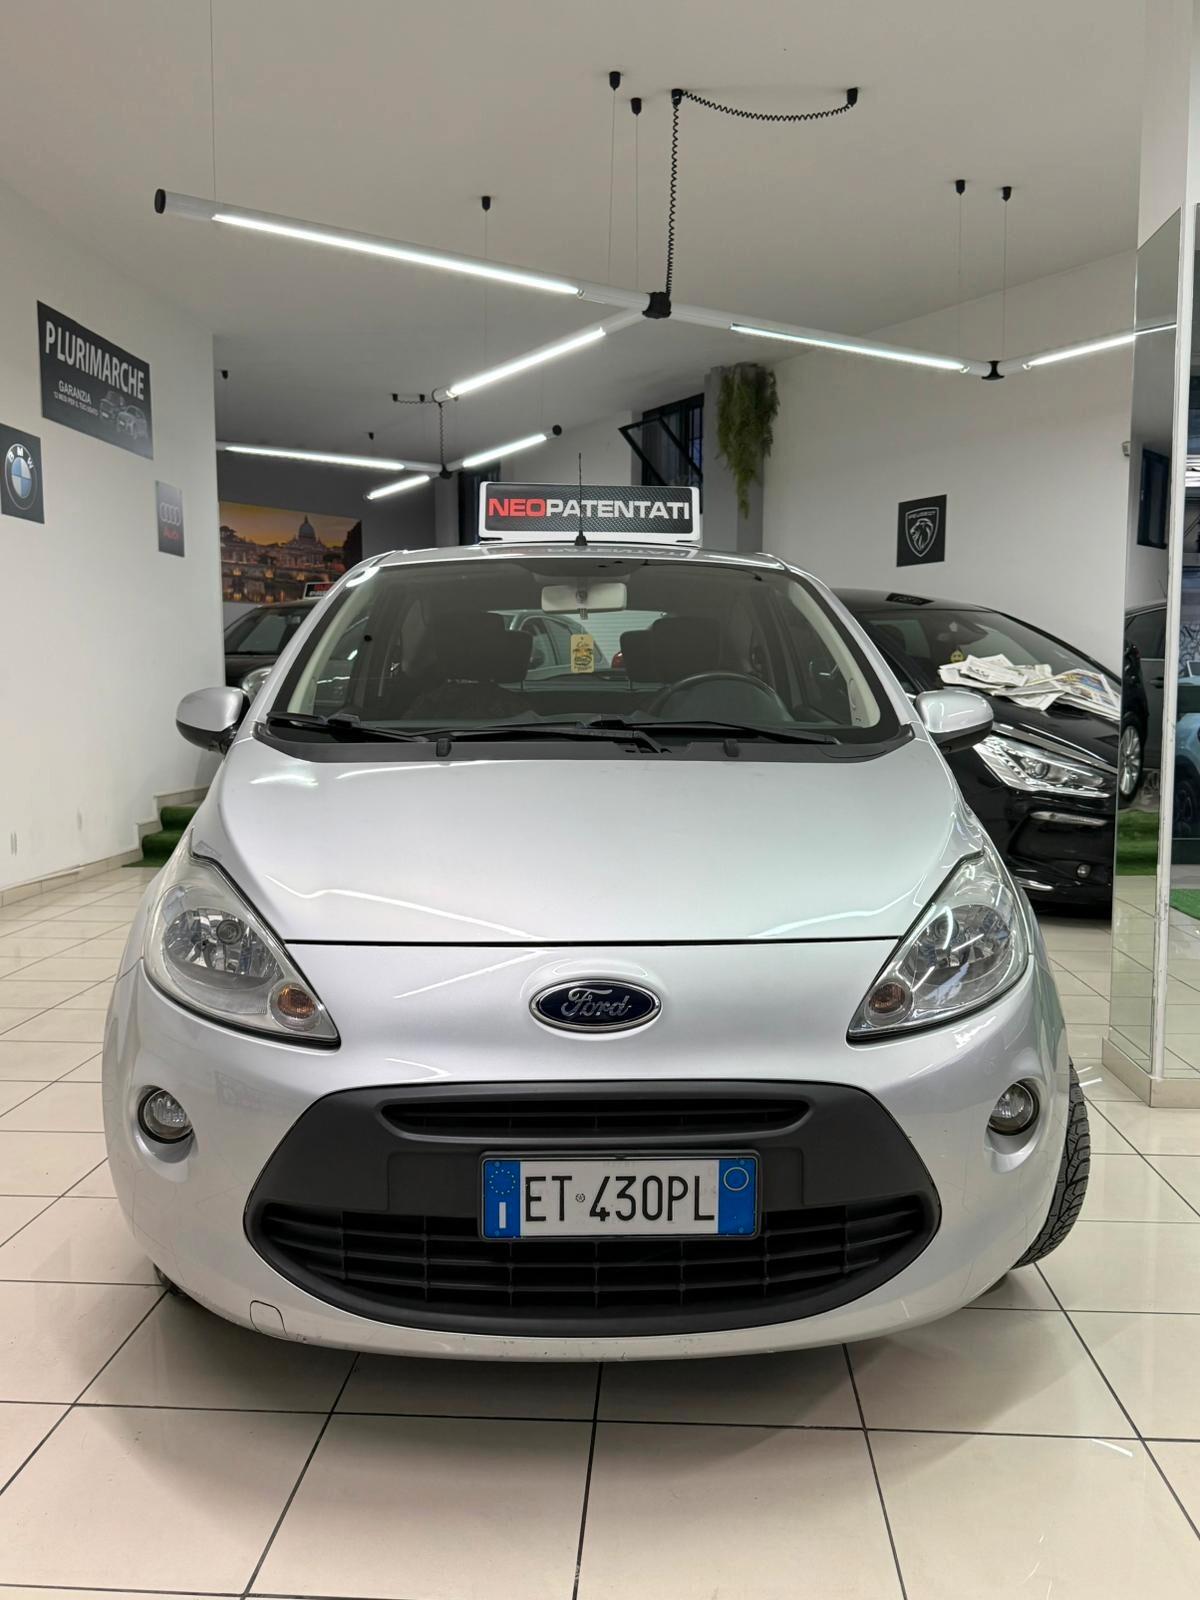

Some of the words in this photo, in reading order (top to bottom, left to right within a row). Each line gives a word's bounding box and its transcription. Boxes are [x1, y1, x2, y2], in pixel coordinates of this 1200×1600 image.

[45, 321, 144, 400] PLURIMARCHE
[58, 380, 92, 405] GARANZIA
[7, 446, 34, 470] BMW
[488, 498, 690, 520] NEOPATENTATI
[560, 987, 632, 1017] Ford
[525, 1175, 573, 1222] ET
[589, 1175, 715, 1222] 430PL
